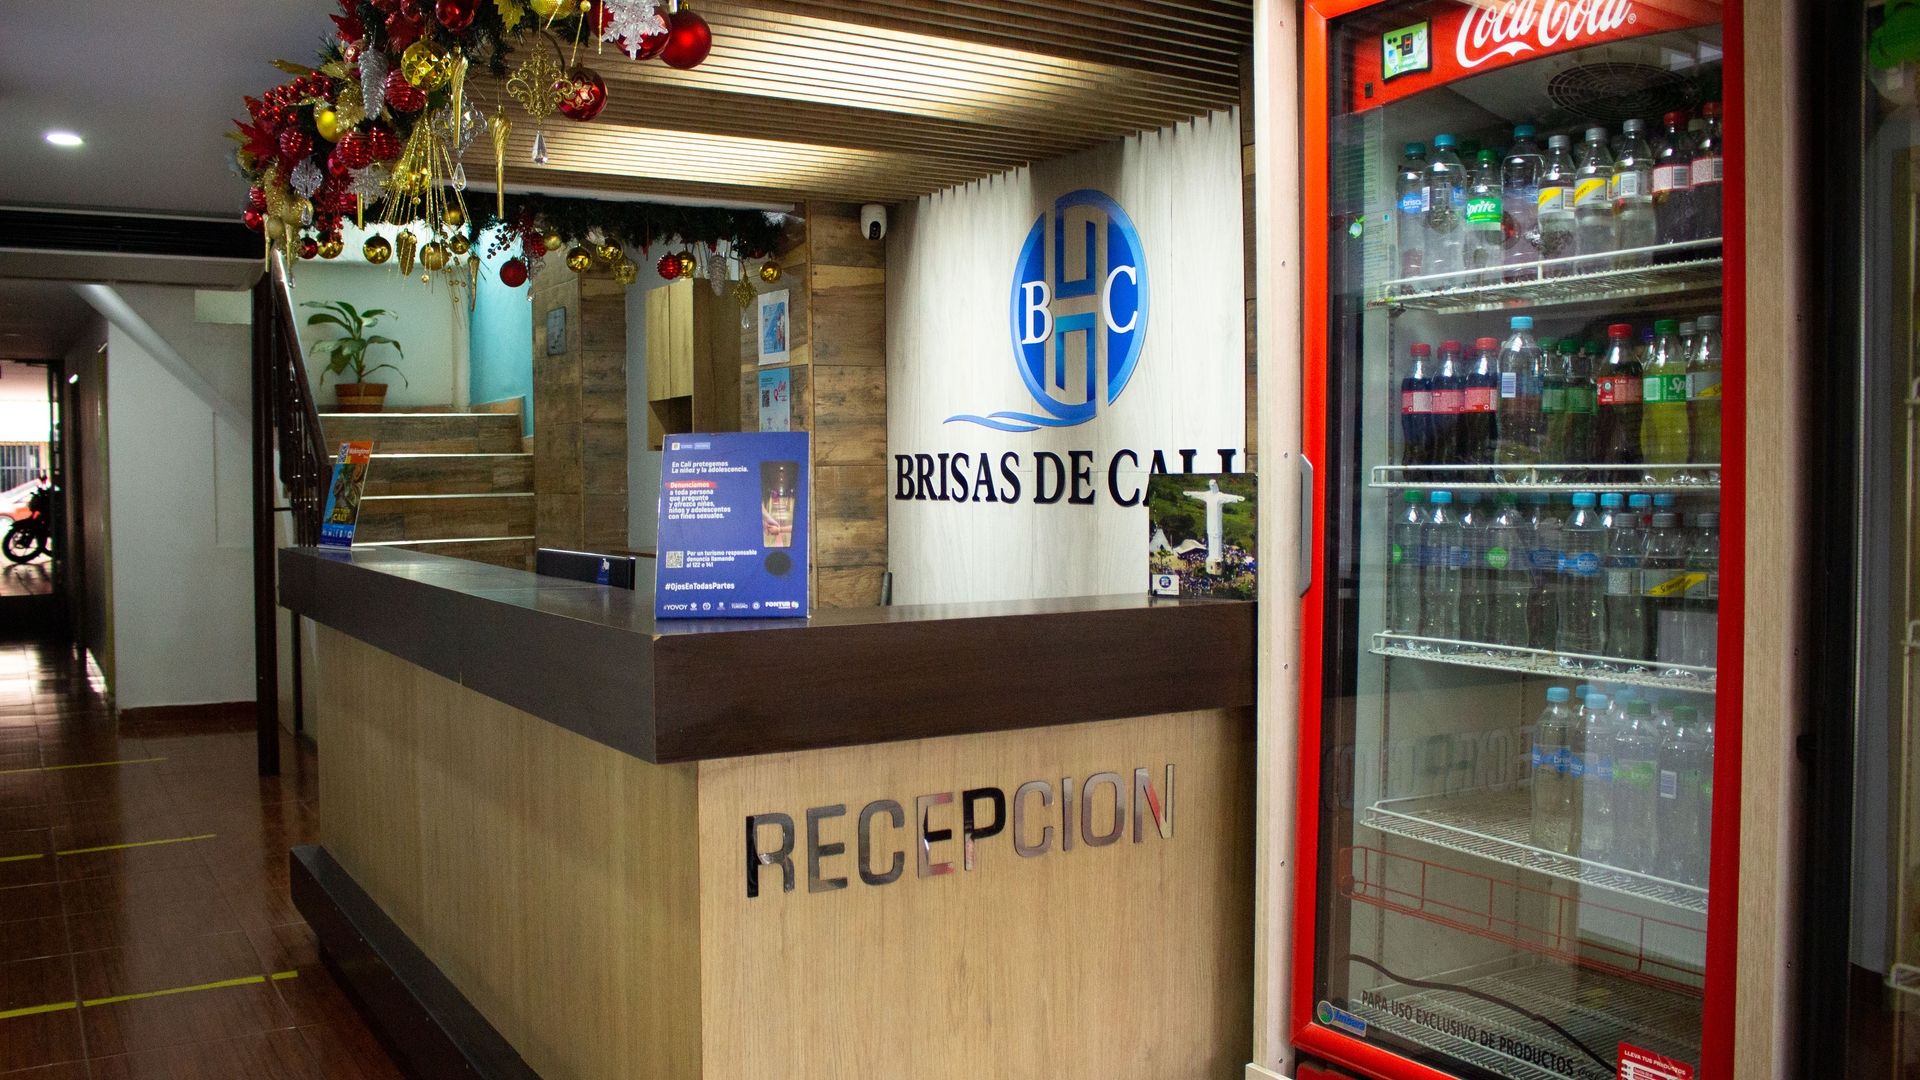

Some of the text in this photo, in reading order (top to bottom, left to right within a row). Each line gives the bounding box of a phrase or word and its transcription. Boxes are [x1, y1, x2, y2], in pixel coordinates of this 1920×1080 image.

[895, 451, 1021, 504] BRISAS
[1033, 450, 1096, 506] DE
[665, 582, 735, 591] #OjosEnTodasPartes
[746, 764, 1175, 898] RECEPCION
[1362, 990, 1388, 1013] PARA
[1391, 1000, 1412, 1020] USO
[1416, 1008, 1476, 1042] EXCLUSIVO
[1480, 1030, 1495, 1049] DE
[1500, 1036, 1574, 1076] PRODUCTOS
[1624, 1050, 1641, 1060] LLEVA
[1642, 1056, 1652, 1064] TUS
